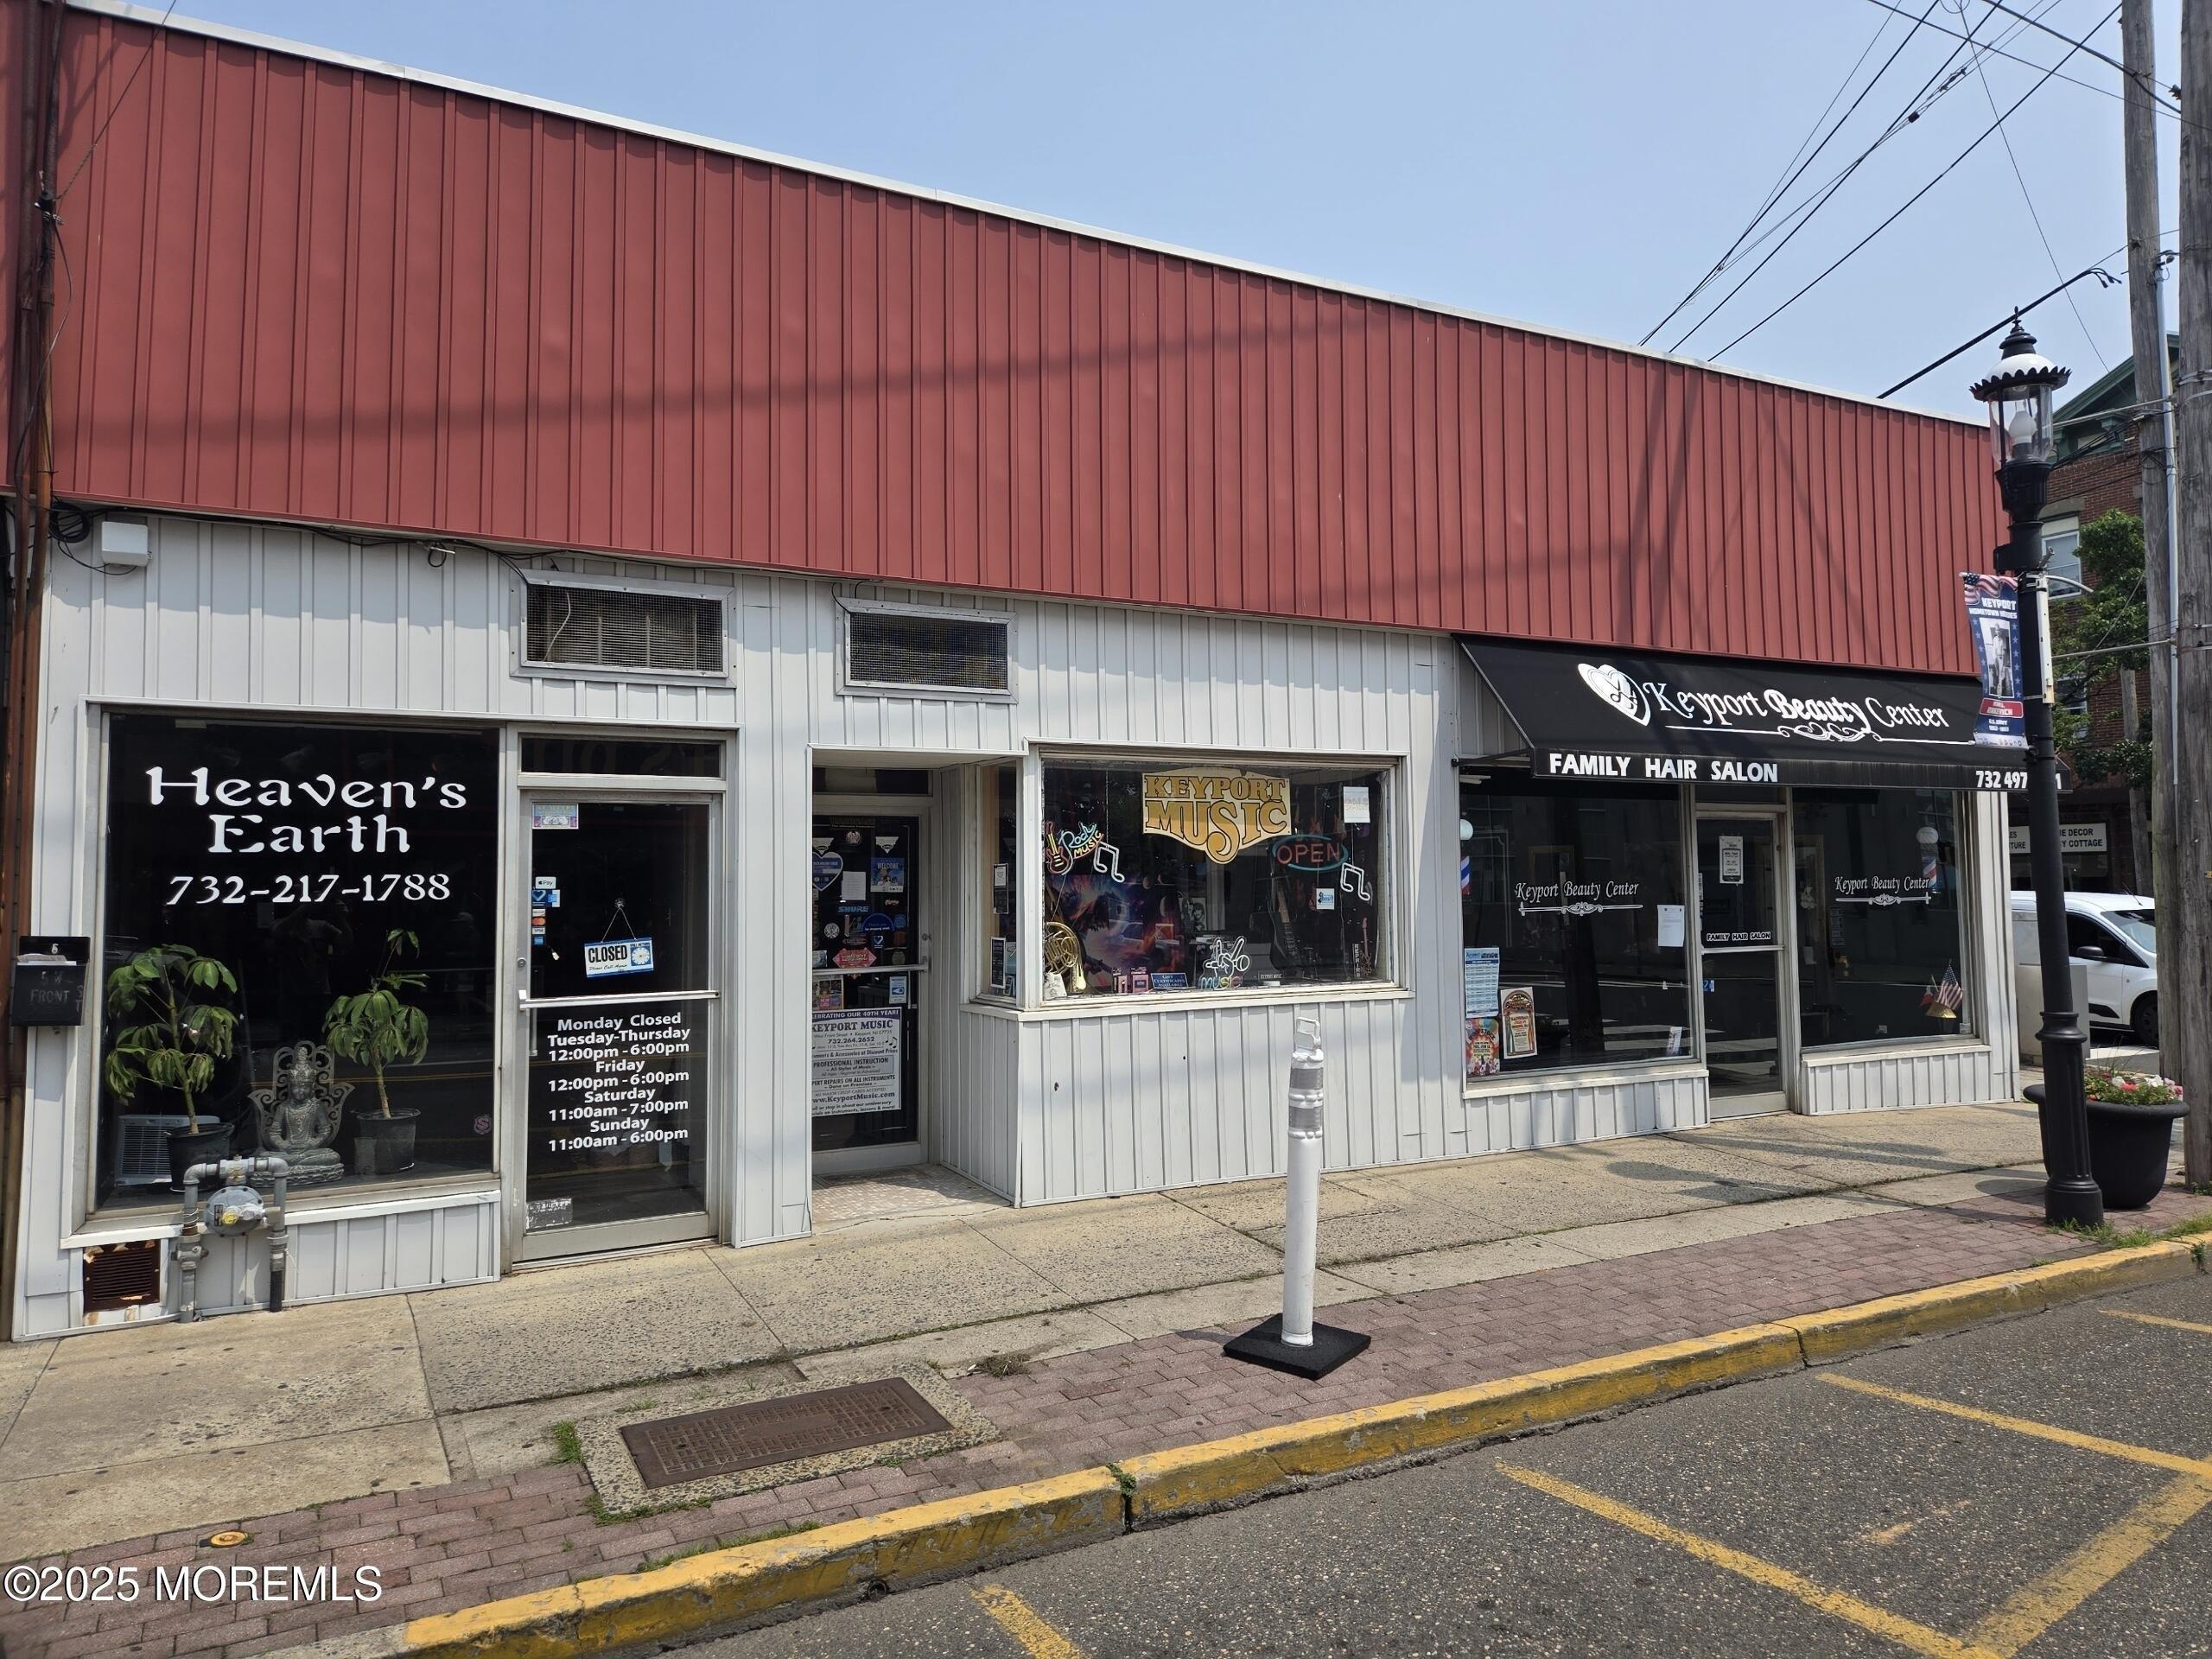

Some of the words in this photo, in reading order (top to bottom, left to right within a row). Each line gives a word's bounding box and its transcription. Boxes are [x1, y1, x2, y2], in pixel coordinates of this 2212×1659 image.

[1981, 597, 2017, 611] KEYPORT
[1643, 681, 1768, 726] Keyport
[1764, 689, 1870, 733] Beauty
[1866, 697, 1950, 728] Center
[1549, 753, 1630, 777] FAMILY
[1644, 758, 1697, 780] HAIR
[1711, 761, 1778, 784] SALON
[145, 766, 467, 810] Heaven's
[1144, 775, 1286, 802] KEYPORT
[1975, 770, 2001, 788] 732
[2004, 772, 2028, 789] 497
[208, 813, 410, 853] Earth
[1145, 800, 1287, 862] MUSIC
[2068, 828, 2094, 836] DECOR
[1073, 830, 1102, 856] MUSIC
[2010, 841, 2026, 849] TURE
[2069, 838, 2102, 848] COTTAGE
[1276, 842, 1340, 865] OPEN
[166, 873, 451, 906] 732-217-1788
[1515, 882, 1559, 904] Keyport
[1563, 881, 1601, 900] Beauty
[1605, 880, 1639, 897] Center
[1834, 876, 1868, 895] Keyport
[1872, 875, 1900, 893] Beauty
[1904, 875, 1930, 891] Center
[1707, 933, 1730, 942] FAMILY
[1732, 932, 1749, 941] HAIR
[1750, 931, 1771, 940] SALON
[588, 945, 628, 963] CLOSED
[30, 989, 70, 1003] FRONT
[557, 1016, 623, 1031] Monday
[630, 1012, 682, 1027] Closed
[861, 1020, 893, 1030] MUSIC
[547, 1027, 690, 1047] Tuesday-Thursday
[828, 1036, 874, 1045] 732.264.2652
[549, 1046, 619, 1062] 12:00pm
[630, 1042, 690, 1056] 6:00pm
[595, 1058, 645, 1073] Friday
[813, 1059, 852, 1068] PROFESSIONAL
[854, 1057, 888, 1065] INSTRUCTION
[549, 1077, 619, 1092] 12:00pm
[630, 1071, 690, 1085] 6:00pm
[584, 1087, 656, 1104] Saturday
[549, 1105, 618, 1122] 11:00am
[629, 1100, 689, 1115] 7:00pm
[590, 1117, 650, 1133] Sunday
[549, 1135, 618, 1152] 11:00am
[629, 1128, 689, 1144] 6:00pm
